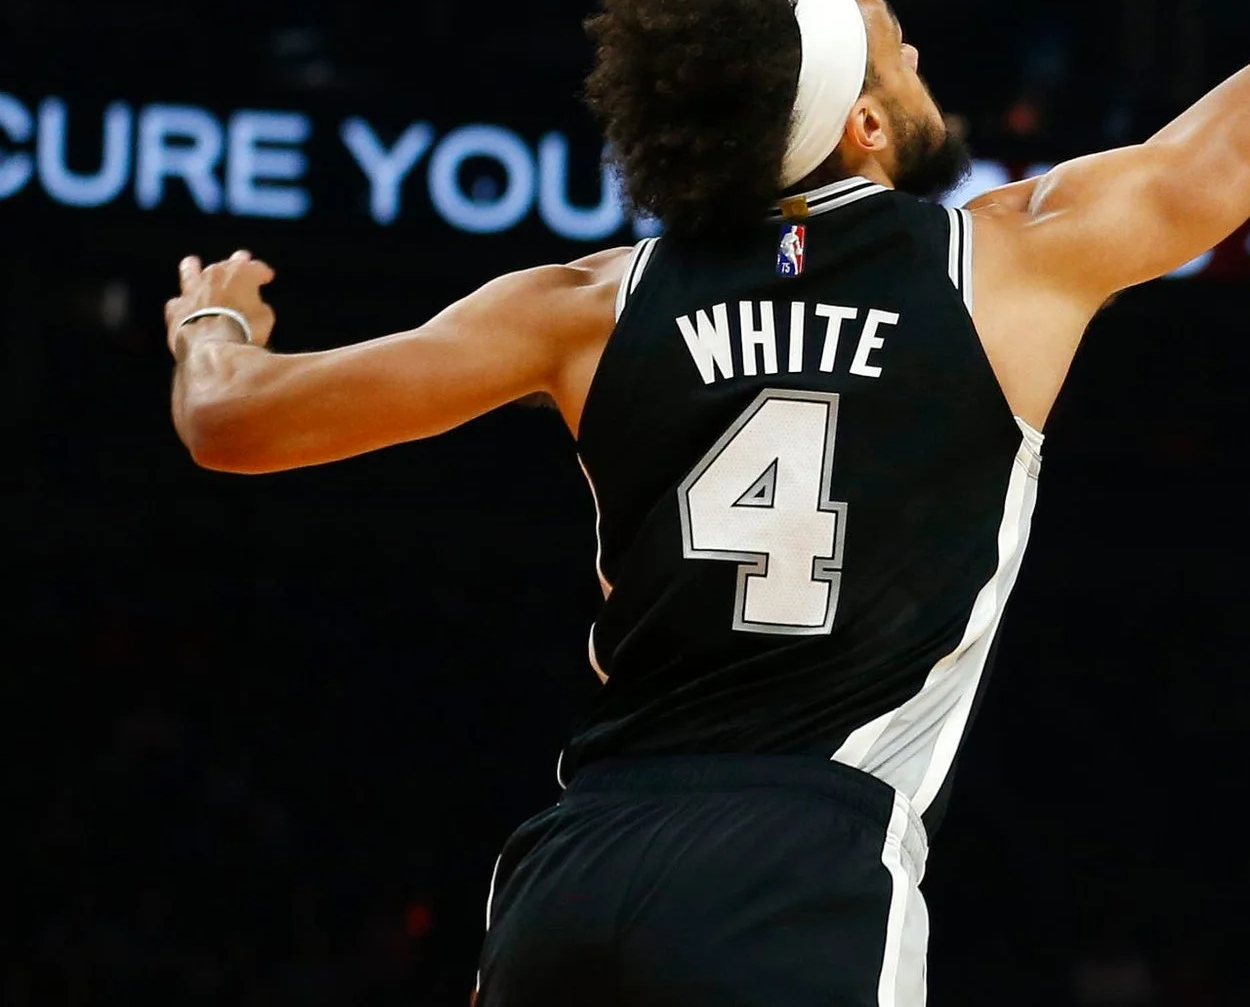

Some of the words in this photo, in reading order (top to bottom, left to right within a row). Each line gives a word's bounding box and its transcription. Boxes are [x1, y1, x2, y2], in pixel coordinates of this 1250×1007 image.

[340, 118, 667, 241] YOU
[675, 300, 900, 385] WHITE
[677, 387, 848, 635] 4
